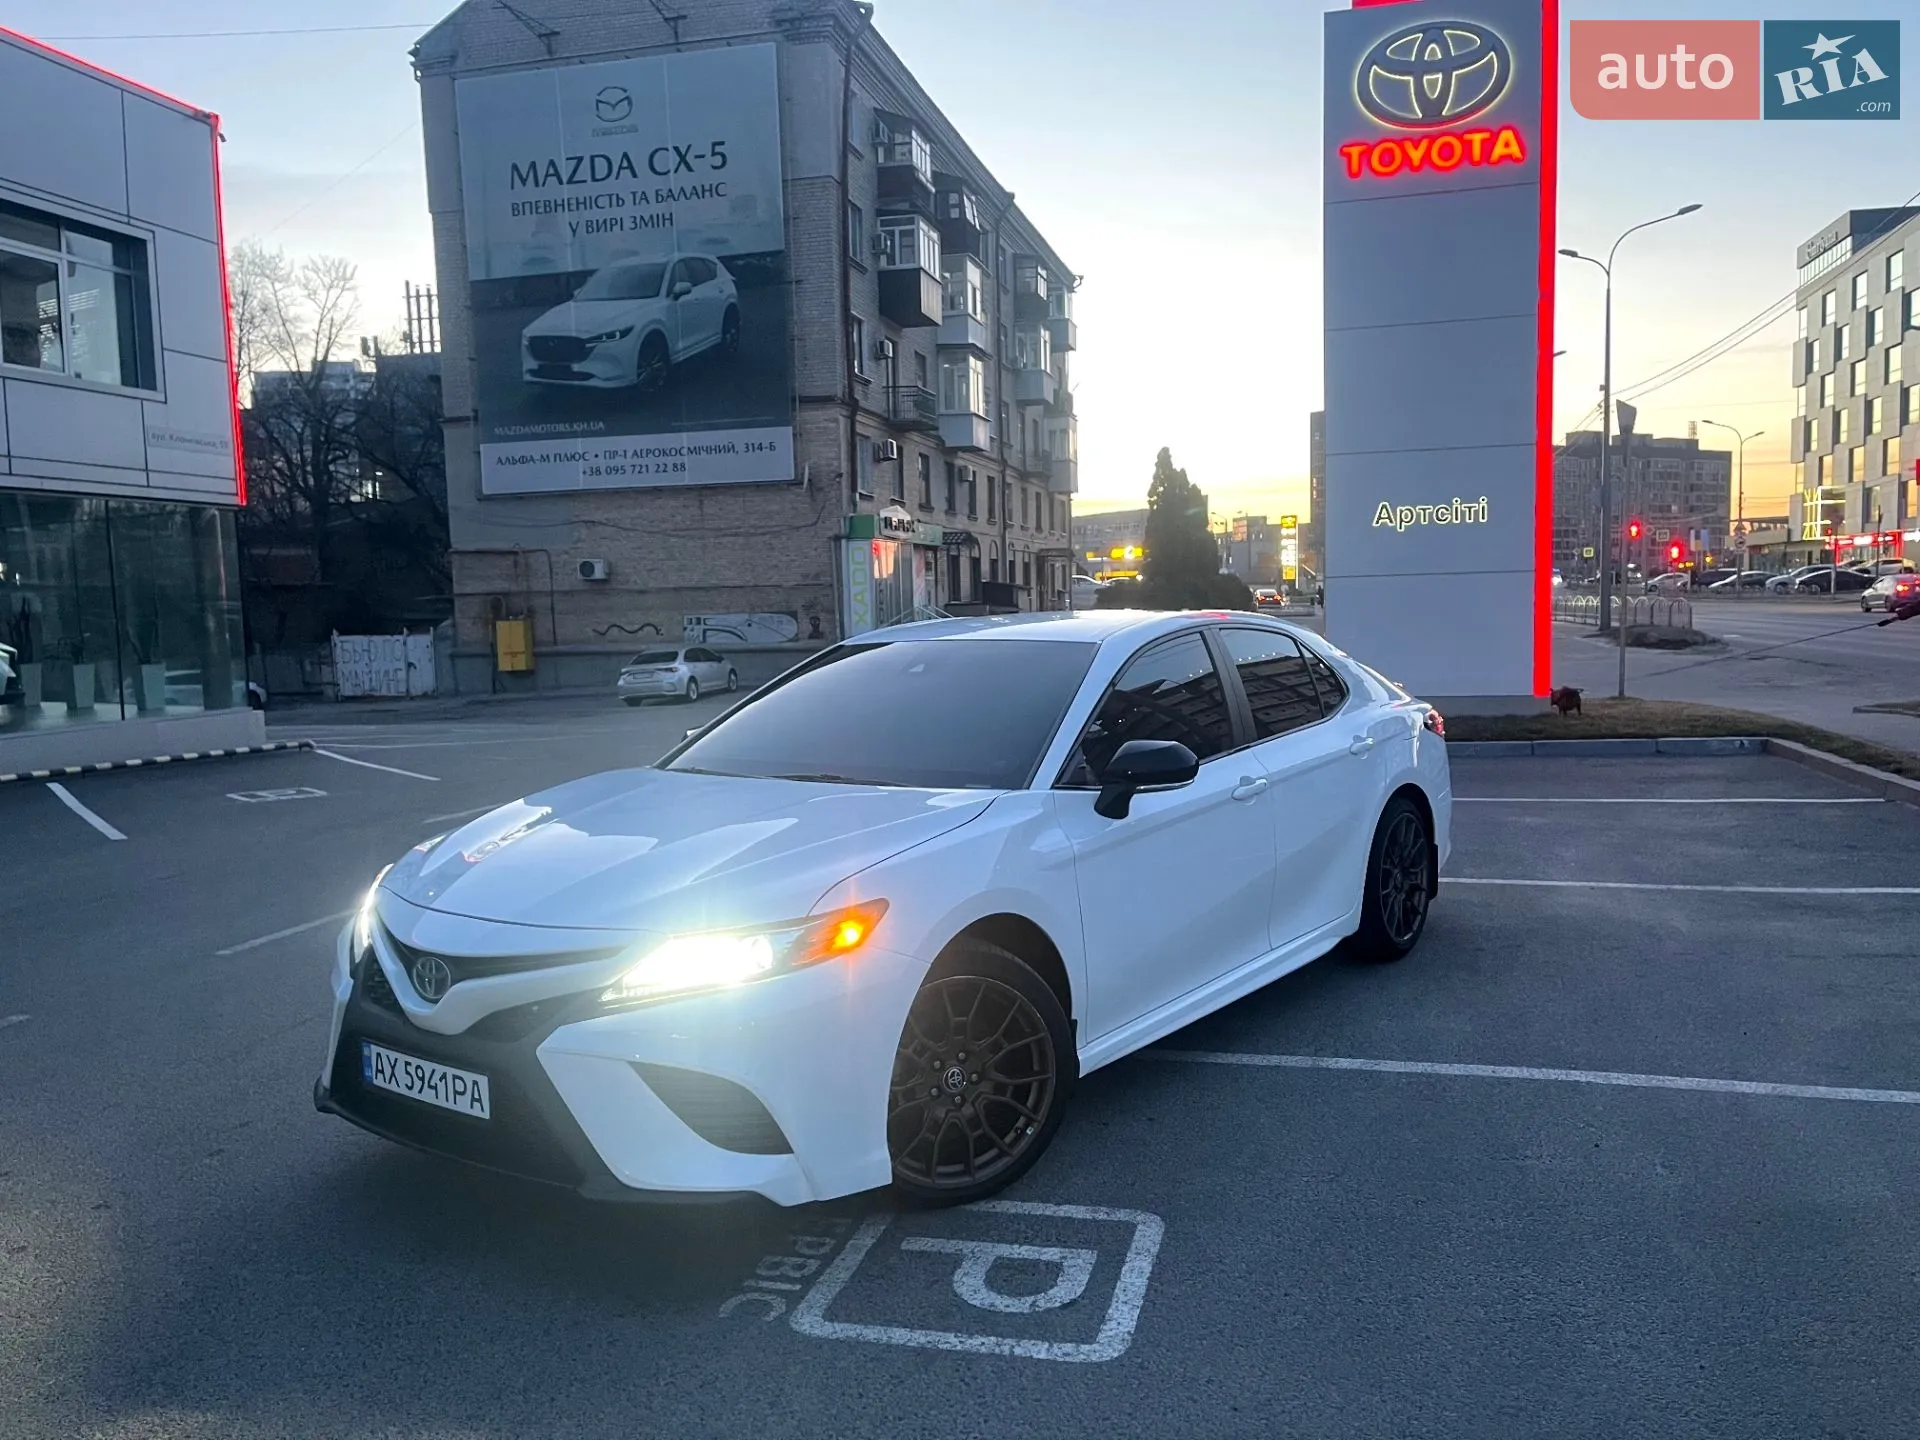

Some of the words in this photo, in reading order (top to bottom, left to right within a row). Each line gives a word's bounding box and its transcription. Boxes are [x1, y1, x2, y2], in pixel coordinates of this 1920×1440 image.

[510, 152, 638, 190] MAZDA
[647, 140, 728, 176] CX-5
[1340, 125, 1525, 179] TOYOTA
[511, 193, 625, 217] ВПЕВНЕНІСТЬ
[630, 190, 650, 207] ТА
[655, 182, 727, 204] БАЛАНС
[568, 220, 580, 238] У
[585, 217, 624, 235] ВИРІ
[629, 212, 673, 231] ЗМІН
[553, 450, 590, 463] ПЛЮС
[605, 464, 626, 475] 095
[630, 463, 651, 474] 721
[654, 463, 668, 473] 22
[1372, 496, 1488, 532] Артсіті
